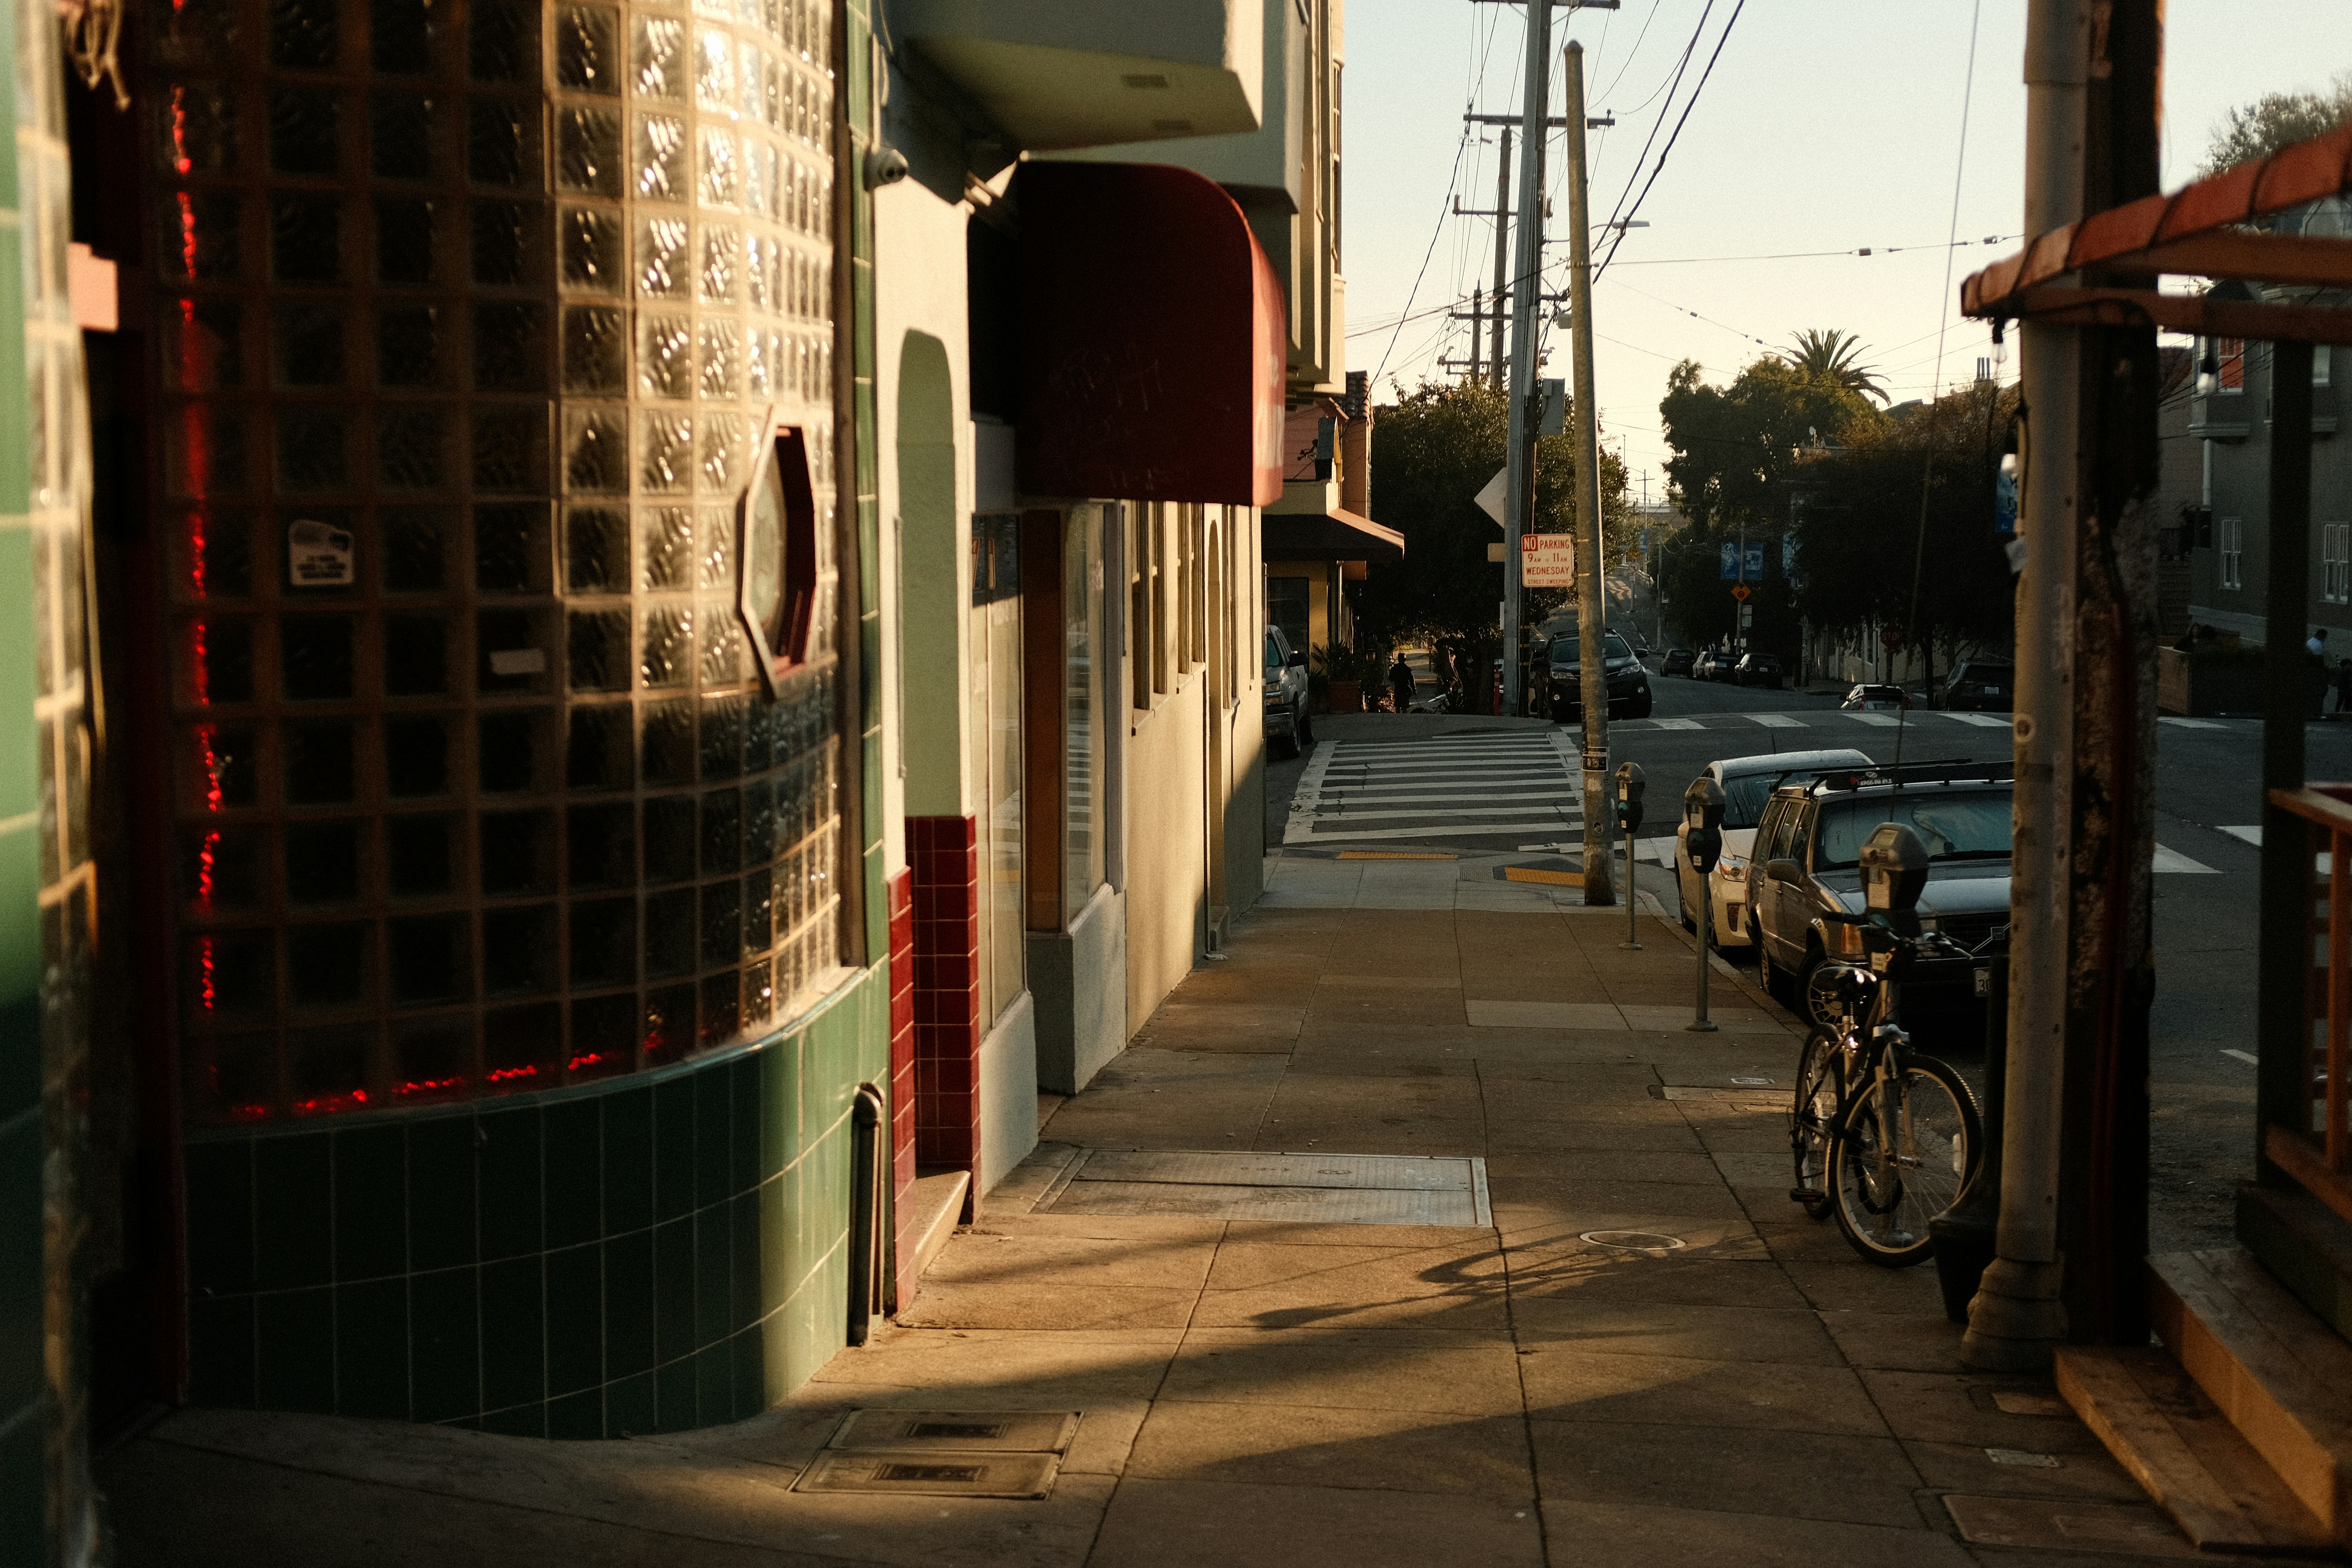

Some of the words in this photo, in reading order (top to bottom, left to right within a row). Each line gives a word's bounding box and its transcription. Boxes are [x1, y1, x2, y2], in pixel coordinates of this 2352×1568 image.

[1524, 536, 1536, 550] NO
[1540, 539, 1569, 549] PARKING
[1526, 566, 1569, 575] WEDNESDAY
